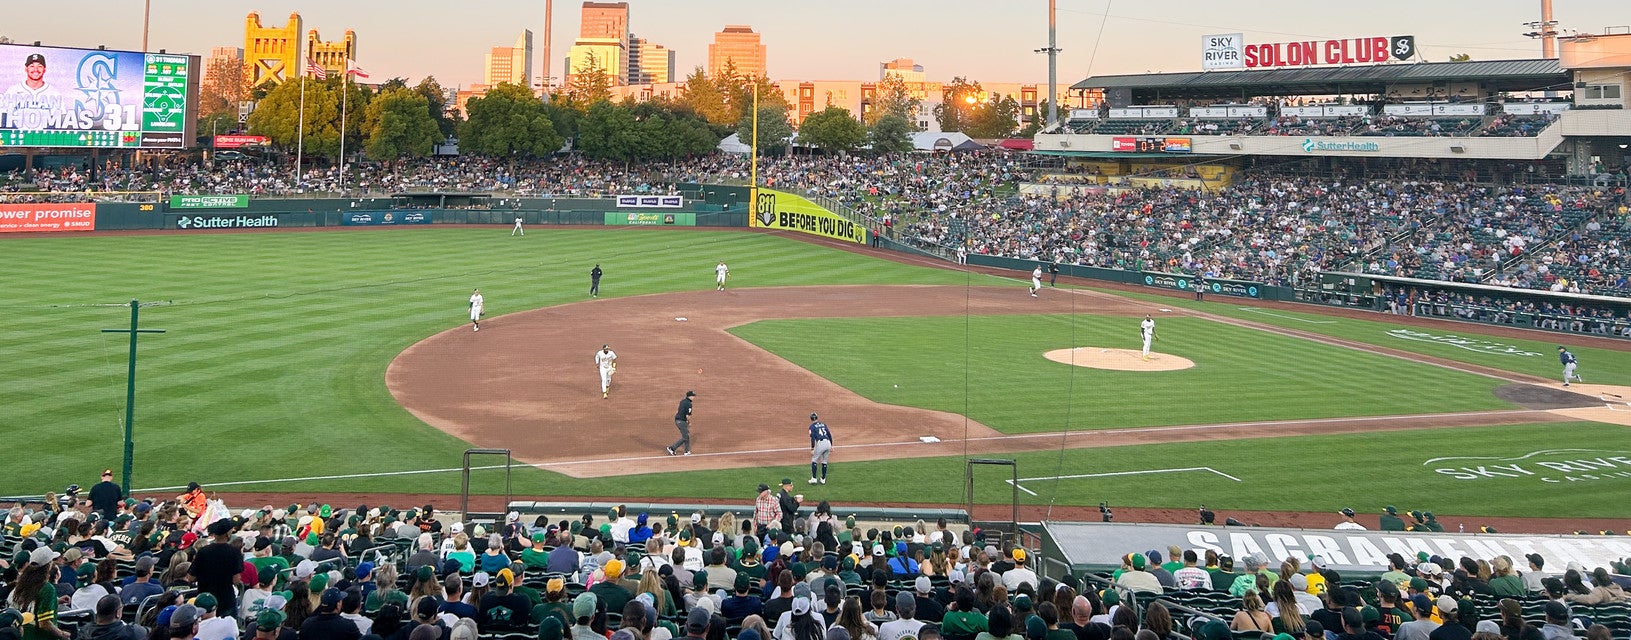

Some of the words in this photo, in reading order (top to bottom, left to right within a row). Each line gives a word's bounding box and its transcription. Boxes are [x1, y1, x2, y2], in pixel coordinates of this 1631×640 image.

[1210, 37, 1233, 47] SKY
[1205, 51, 1239, 60] RIVER
[1244, 41, 1318, 68] SOLON
[1324, 37, 1389, 64] CLUB
[103, 103, 140, 131] 31
[1317, 141, 1347, 150] Sutter
[1347, 141, 1379, 151] Health
[758, 193, 776, 215] 811
[35, 207, 91, 222] promise
[193, 216, 235, 228] Sutter
[236, 215, 278, 227] Health
[779, 211, 817, 232] BEFORE
[817, 216, 836, 236] YOU
[837, 219, 854, 239] DIG
[818, 427, 827, 437] 45
[1434, 464, 1536, 480] SKY
[1384, 613, 1402, 625] ZITO
